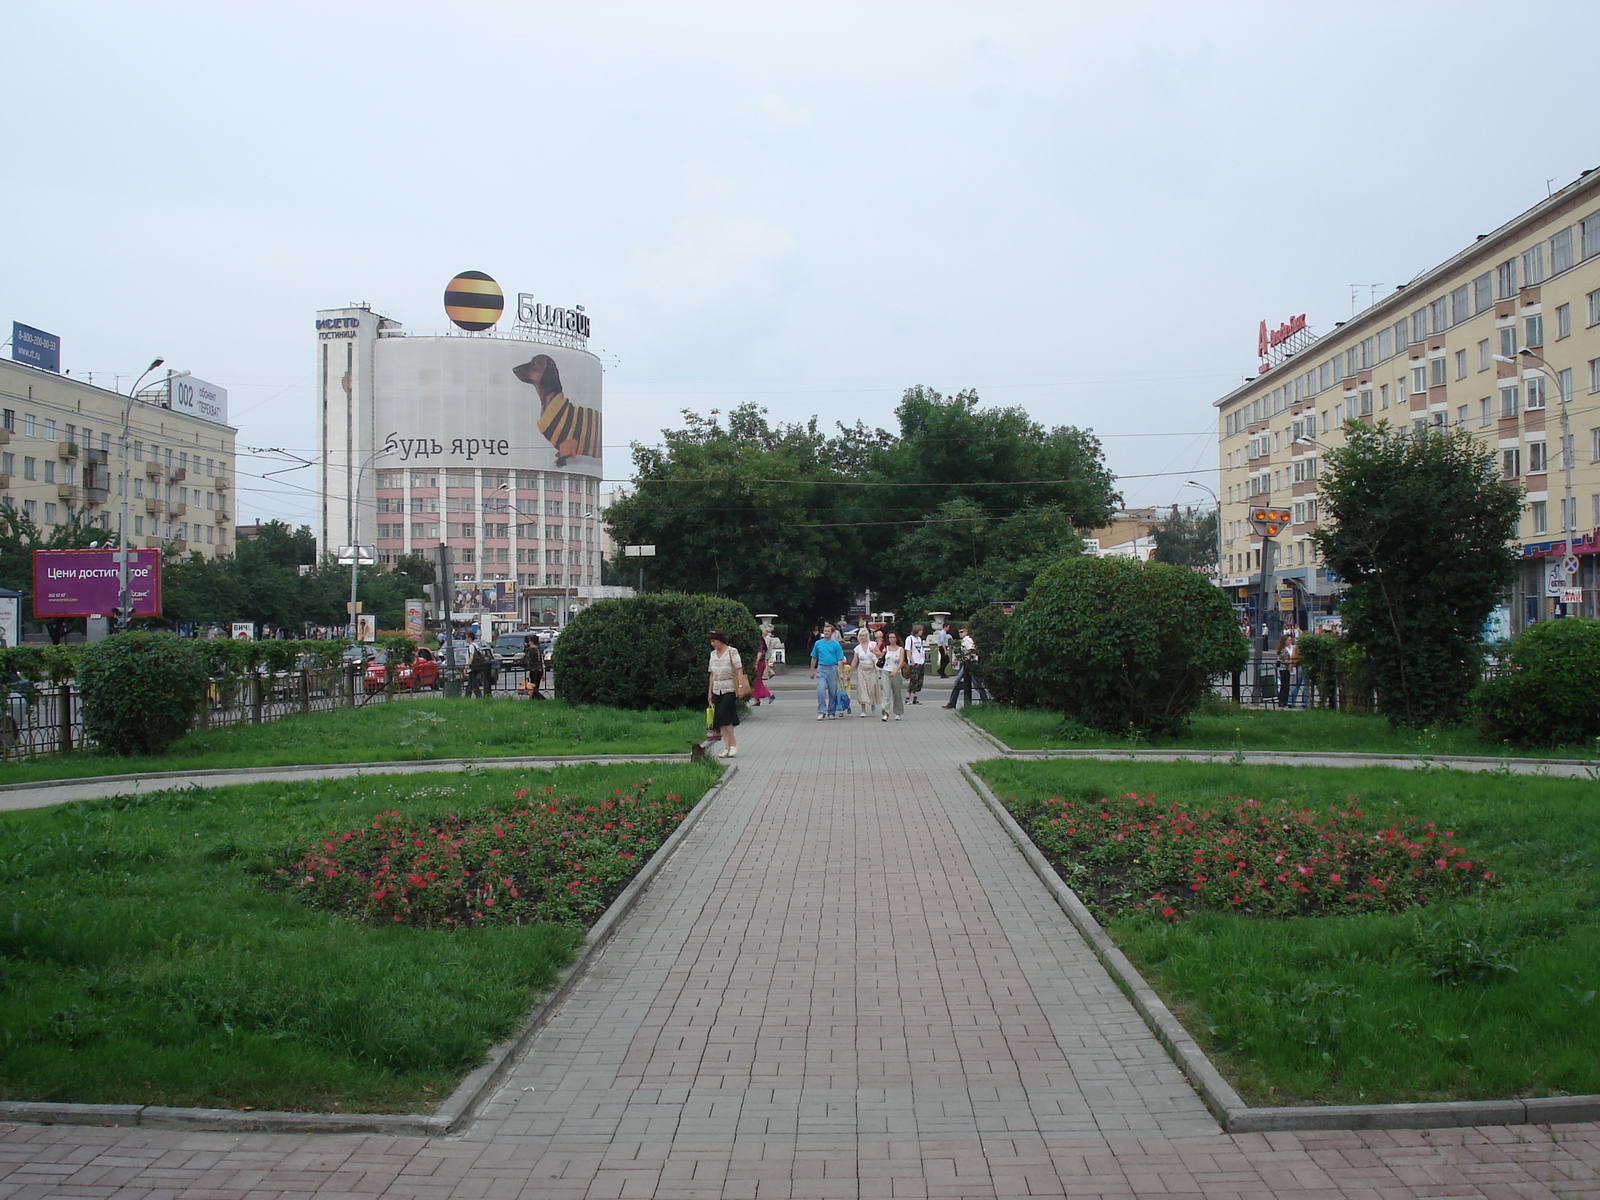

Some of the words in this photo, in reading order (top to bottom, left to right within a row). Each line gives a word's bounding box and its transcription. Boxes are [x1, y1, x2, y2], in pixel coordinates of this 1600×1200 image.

[315, 317, 360, 330] ИСЕТЬ
[518, 292, 590, 338] Билайн
[18, 330, 56, 351] 8-800-200-00-33
[318, 330, 357, 340] ГОСТИНИЦА
[178, 382, 194, 408] 002
[385, 431, 443, 461] будь
[450, 438, 509, 461] ярче
[47, 567, 77, 580] Цени
[78, 568, 149, 580] достигое
